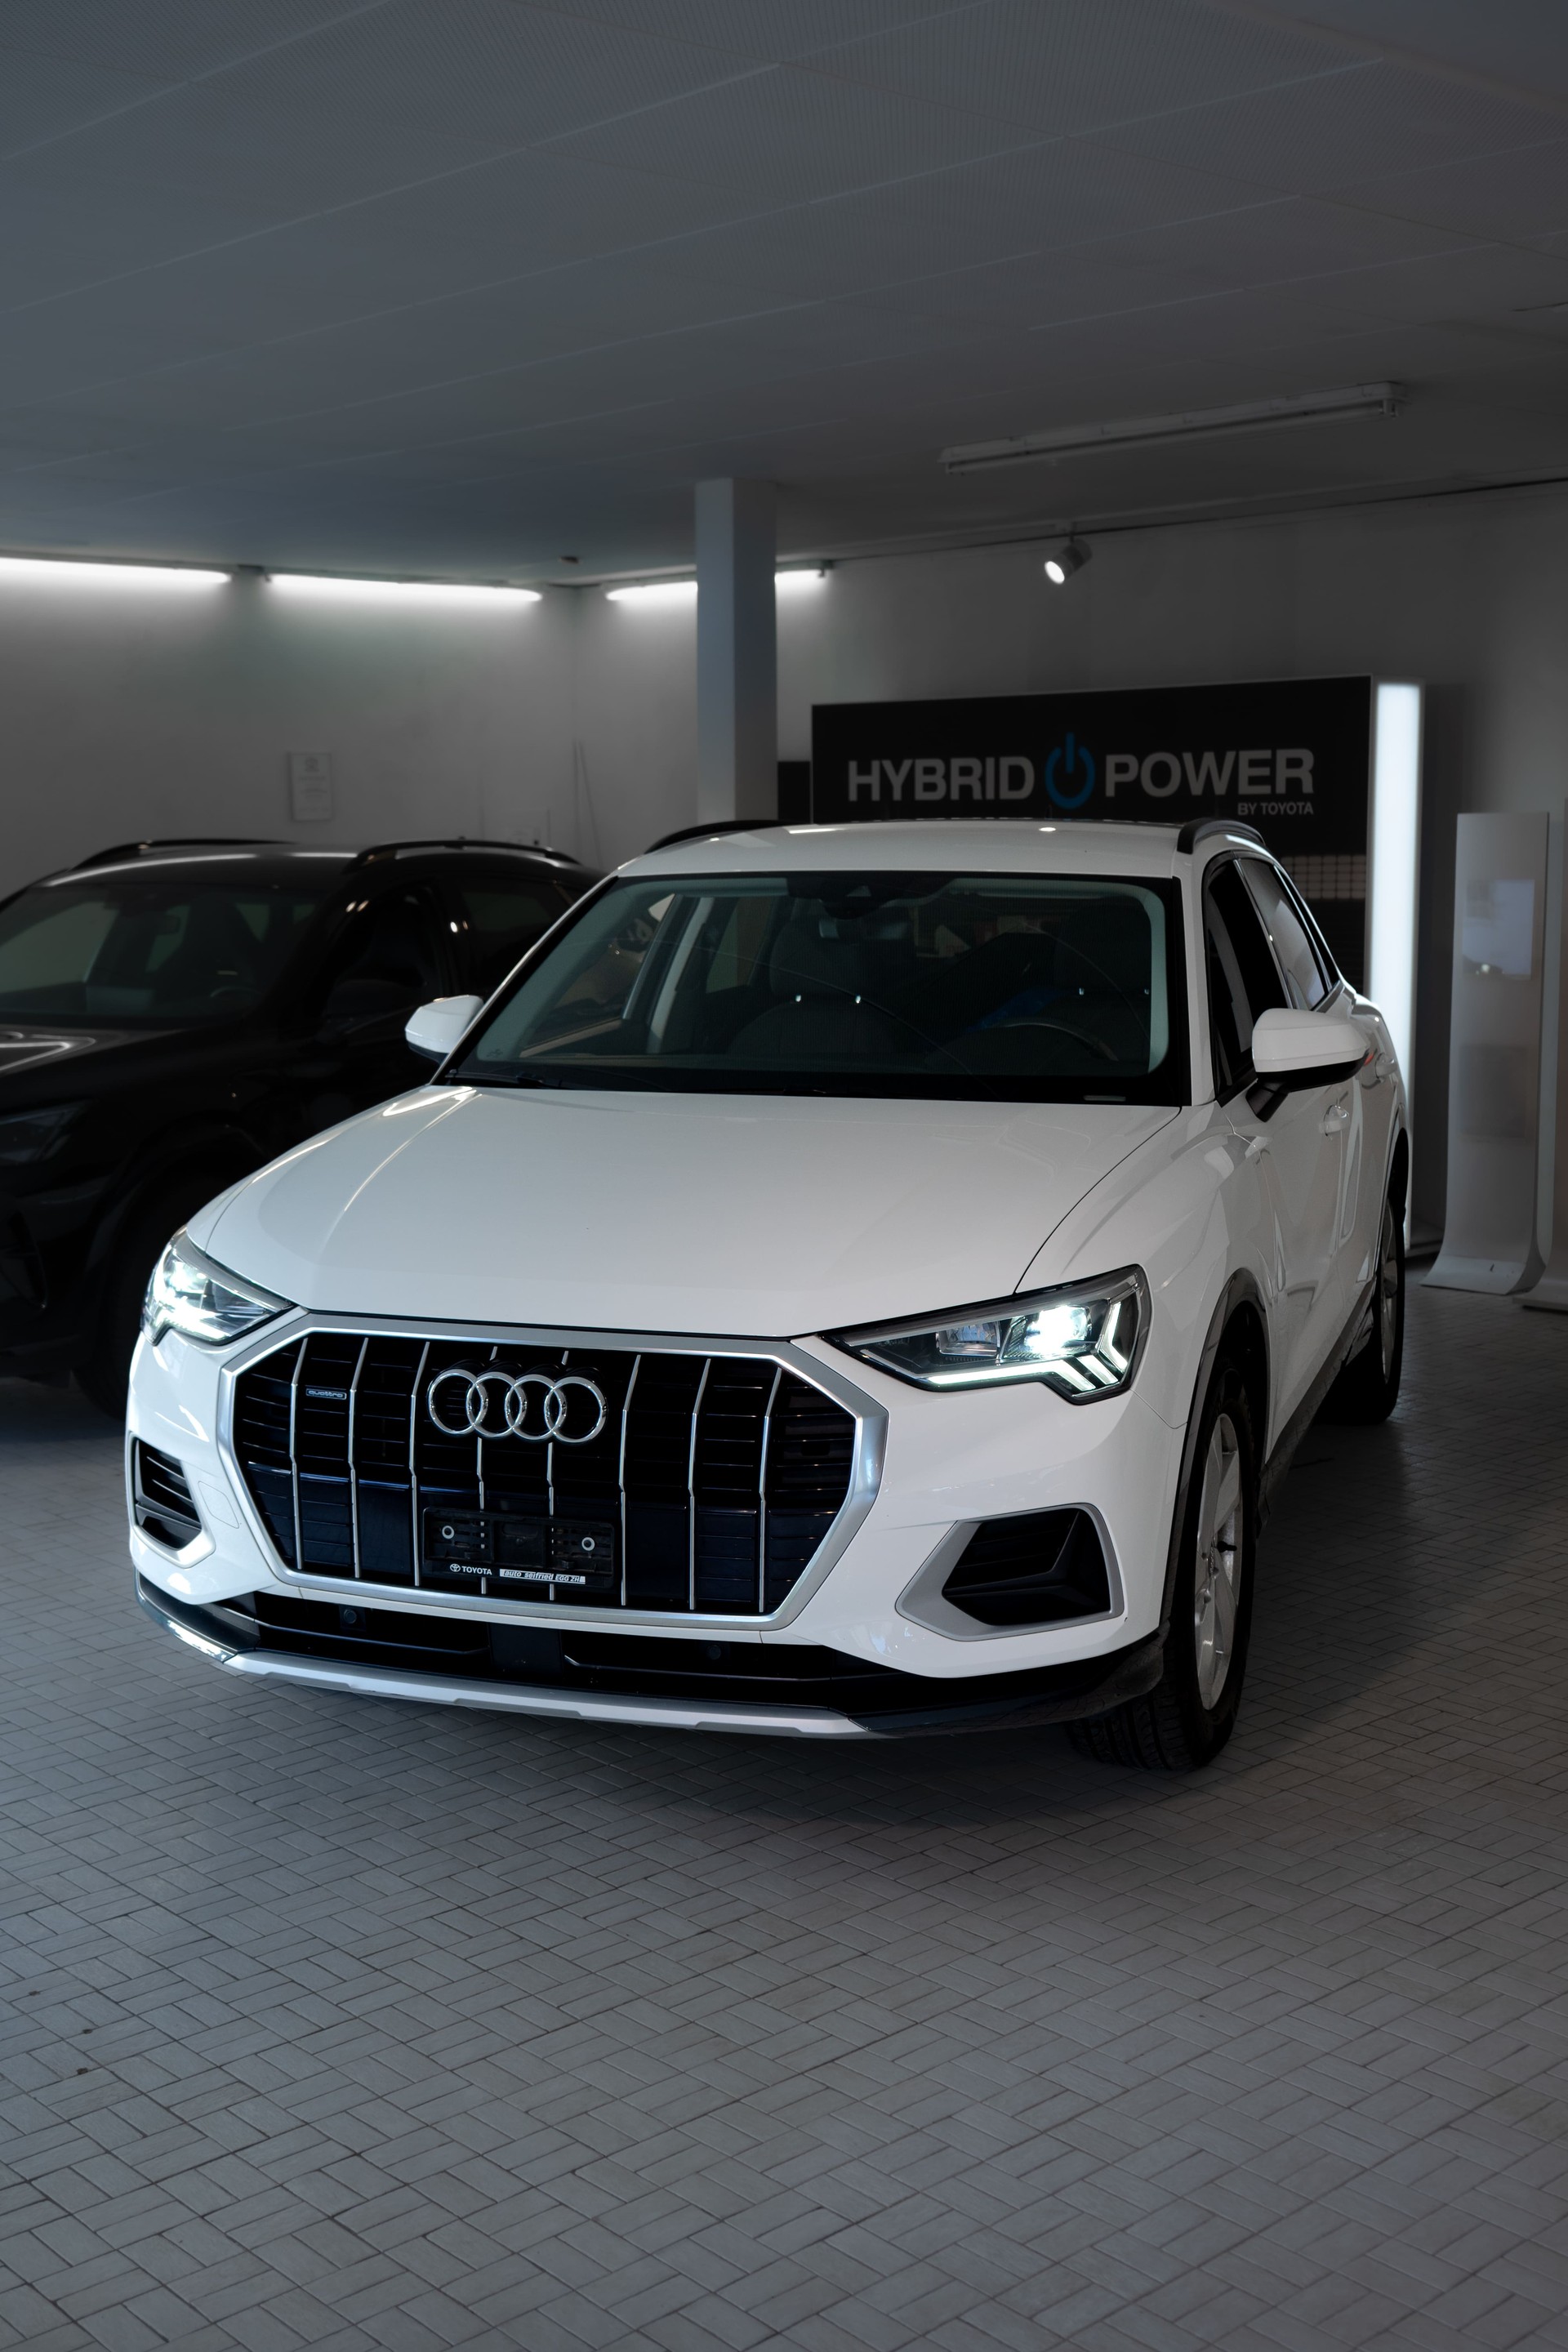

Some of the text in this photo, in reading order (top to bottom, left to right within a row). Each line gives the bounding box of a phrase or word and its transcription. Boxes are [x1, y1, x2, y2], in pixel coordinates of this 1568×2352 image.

[848, 748, 1314, 801] HYBRID POWER
[1237, 800, 1315, 816] BY TOYOTA
[308, 1390, 343, 1398] quattro
[461, 1566, 492, 1575] TOYOTA
